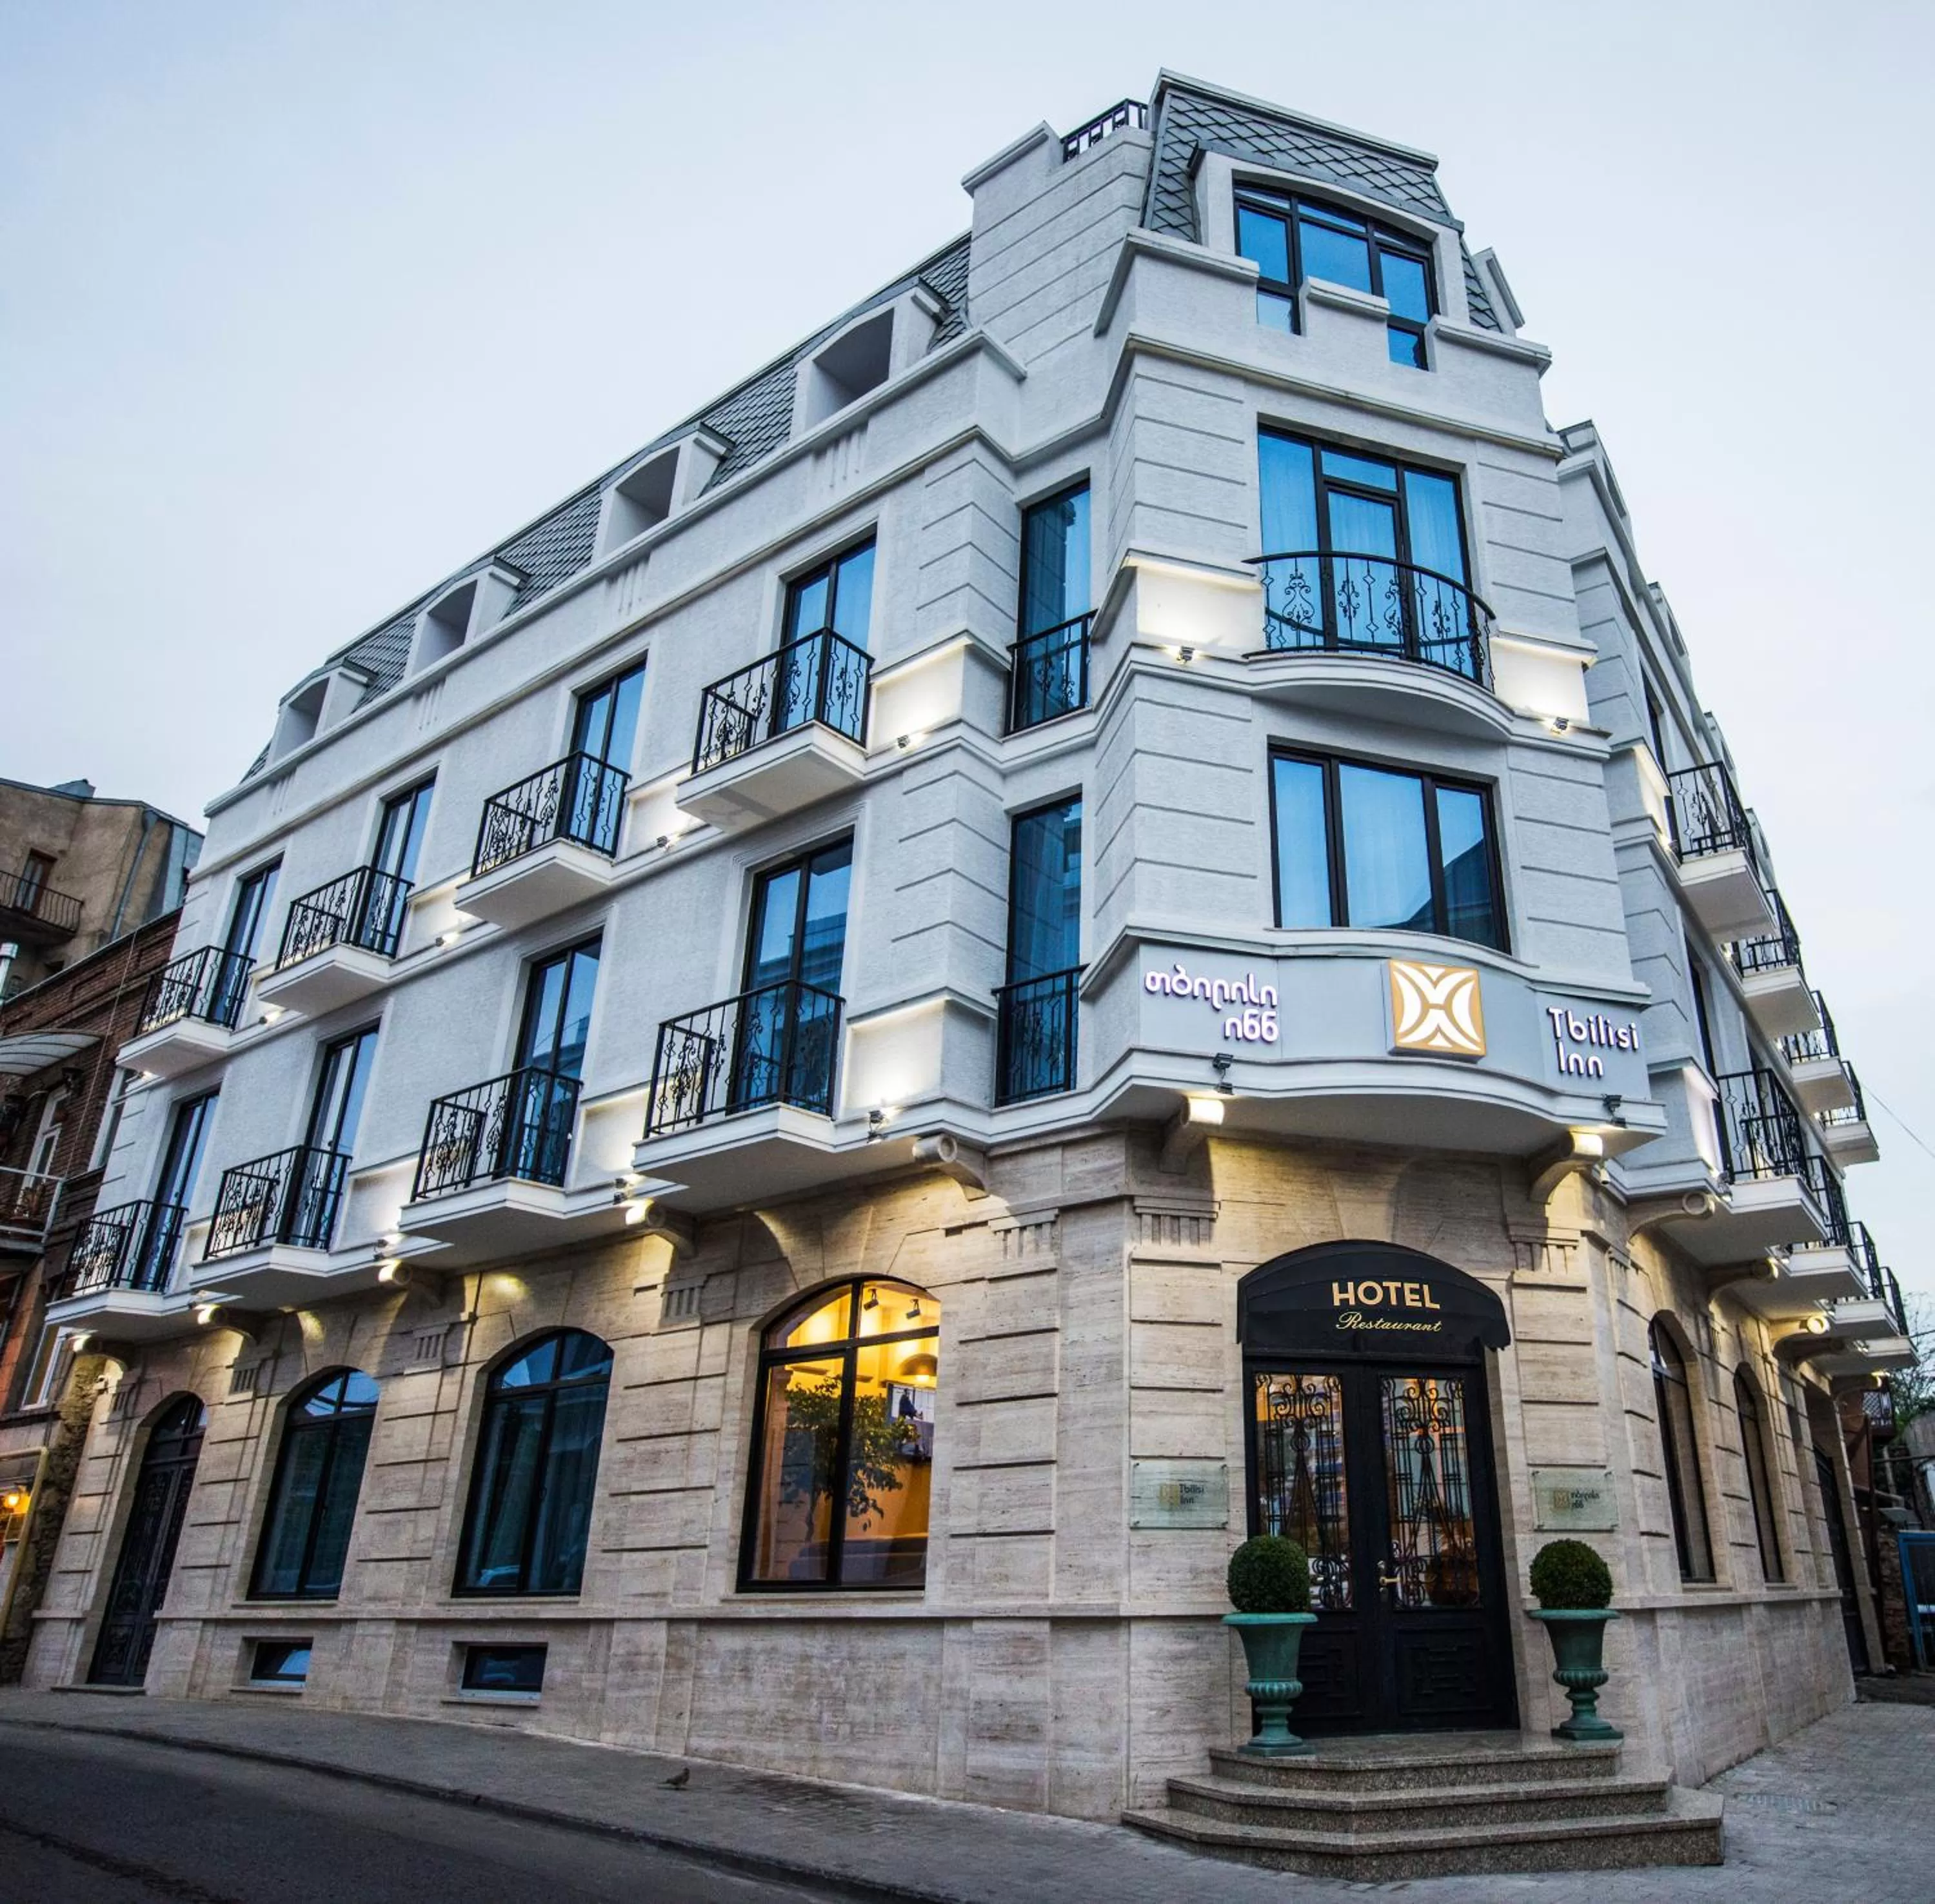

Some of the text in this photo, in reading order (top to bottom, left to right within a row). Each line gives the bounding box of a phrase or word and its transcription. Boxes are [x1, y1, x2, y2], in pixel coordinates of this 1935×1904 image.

[1145, 964, 1278, 1011] თბილისი
[1224, 1009, 1279, 1043] ინნ
[1547, 1007, 1639, 1050] Tbilisi
[1556, 1041, 1603, 1078] Inn
[1332, 1281, 1440, 1309] HOTEL
[1336, 1311, 1442, 1332] Restaurant
